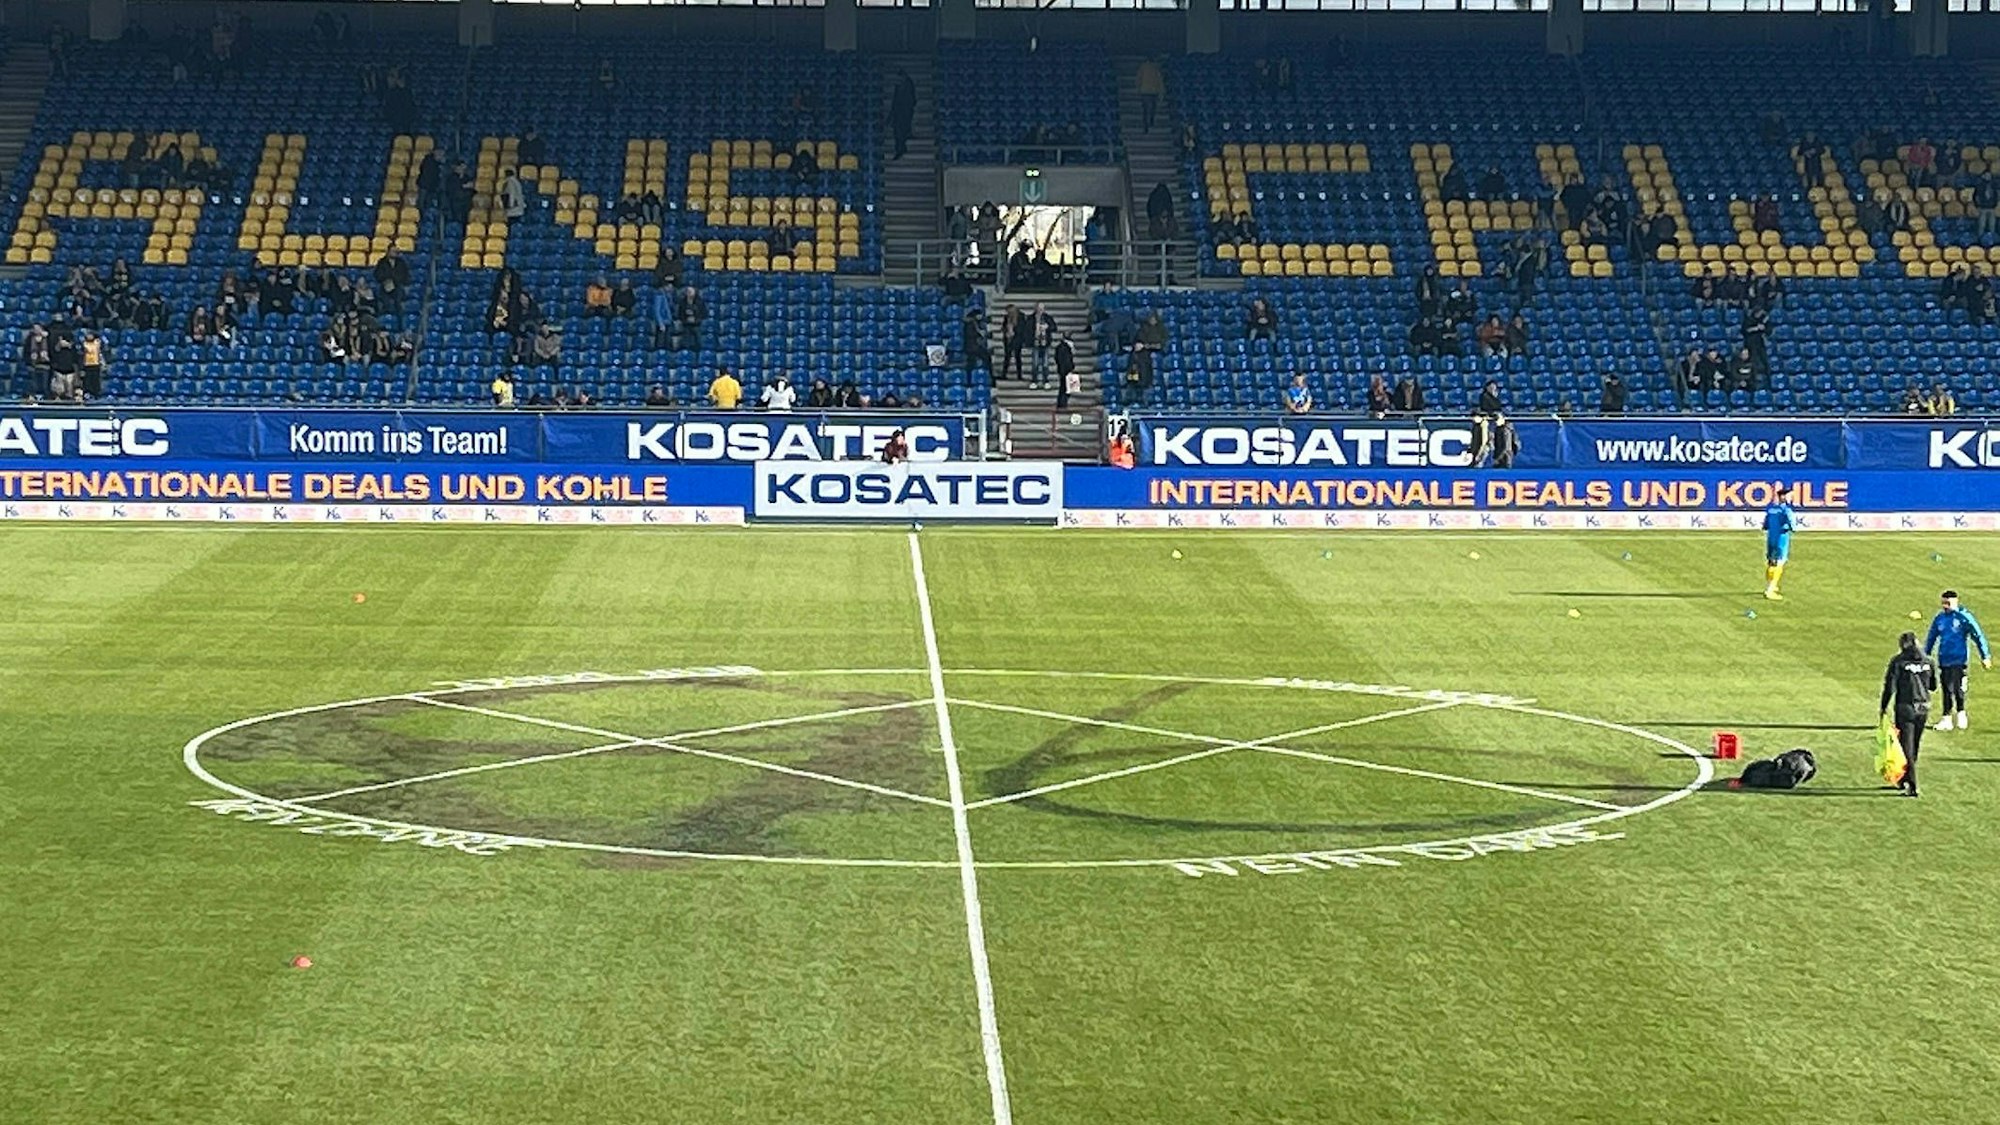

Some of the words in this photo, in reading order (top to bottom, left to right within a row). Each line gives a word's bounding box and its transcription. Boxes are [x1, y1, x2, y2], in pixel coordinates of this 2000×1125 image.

[290, 424, 374, 453] Komm
[382, 425, 423, 454] ins
[426, 426, 507, 454] Team!
[628, 423, 949, 461] KOSATEC
[1153, 427, 1474, 466] KOSATEC
[1596, 435, 1808, 463] www.kosatec.de
[0, 470, 292, 498] TERNATIONALE
[304, 473, 431, 500] DEALS
[441, 474, 525, 500] UND
[537, 475, 669, 501] KOHLE
[767, 473, 1051, 504] KOSATEC
[1150, 479, 1476, 506] INTERNATIONALE
[1486, 480, 1611, 507] DEALS
[1622, 480, 1706, 507] UND
[1717, 480, 1849, 507] KOHLE
